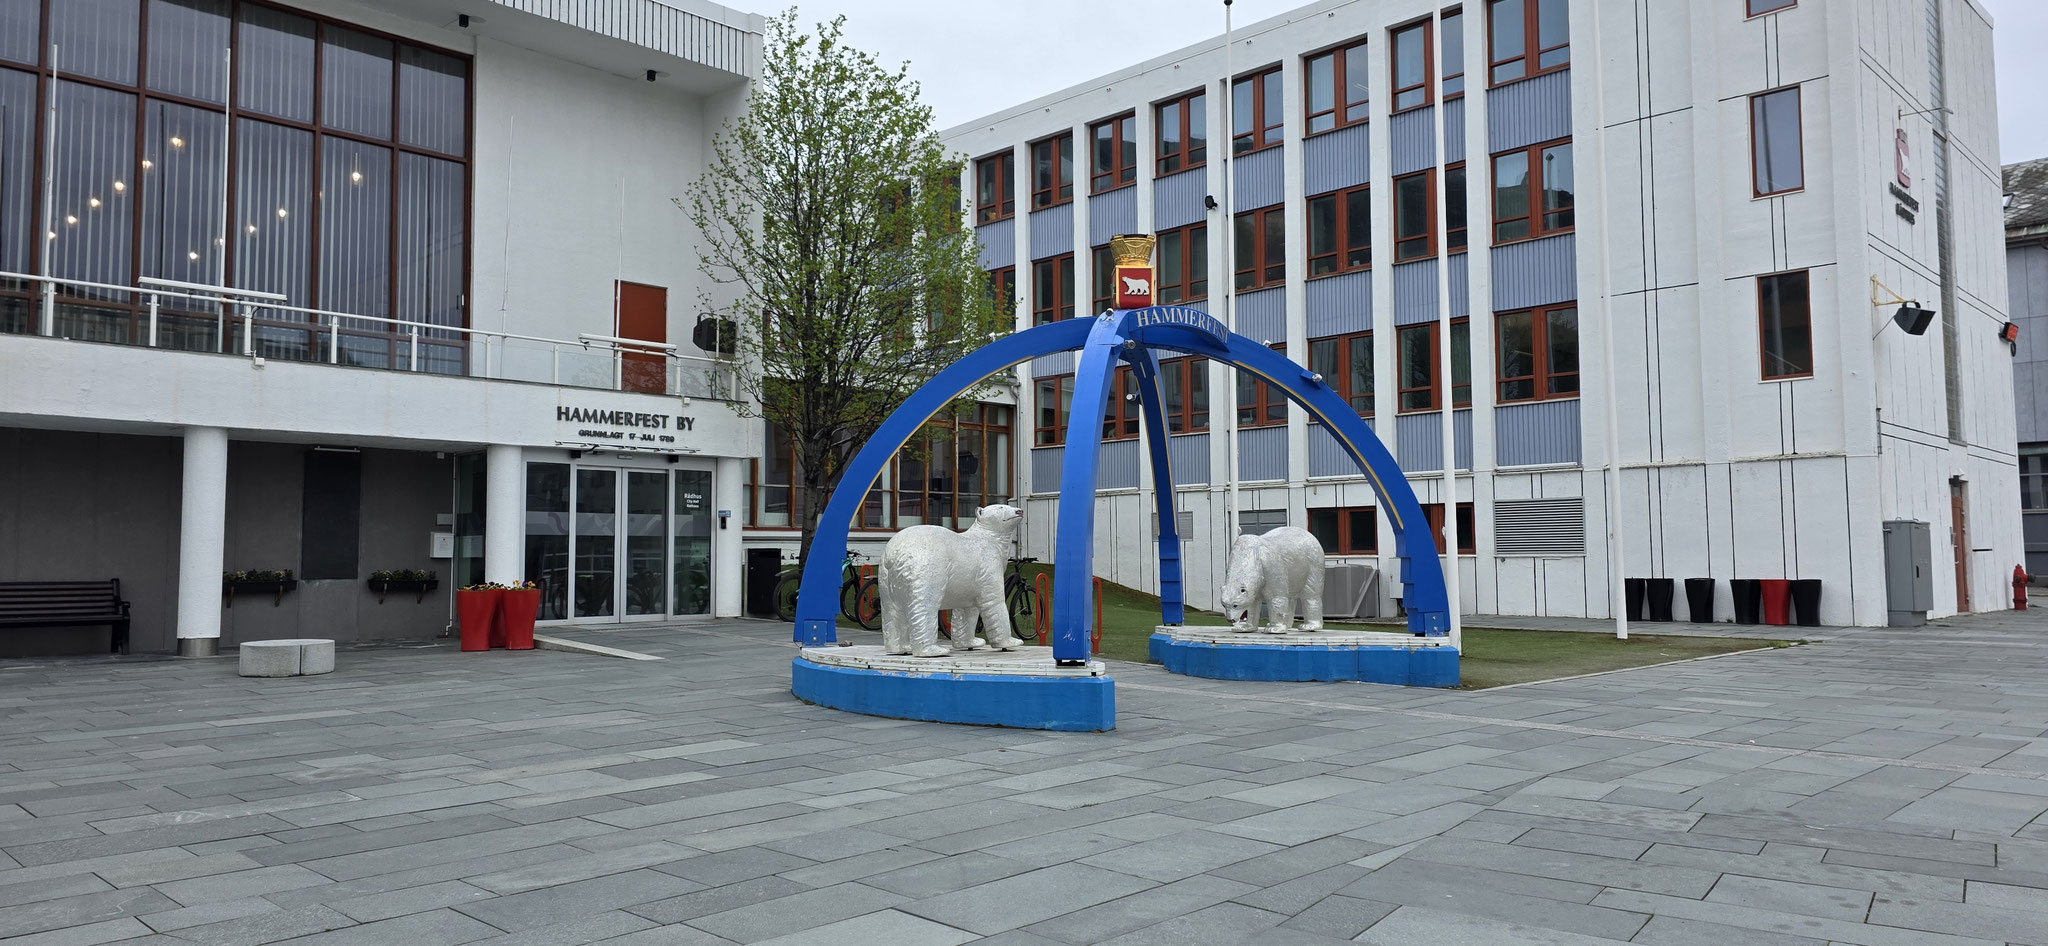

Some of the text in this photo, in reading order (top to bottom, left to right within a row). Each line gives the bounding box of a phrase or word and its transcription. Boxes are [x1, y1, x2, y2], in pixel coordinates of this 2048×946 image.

[1136, 307, 1230, 344] HAMMERFEST
[557, 406, 695, 431] HAMMERFEST BY
[640, 433, 655, 441] JULI
